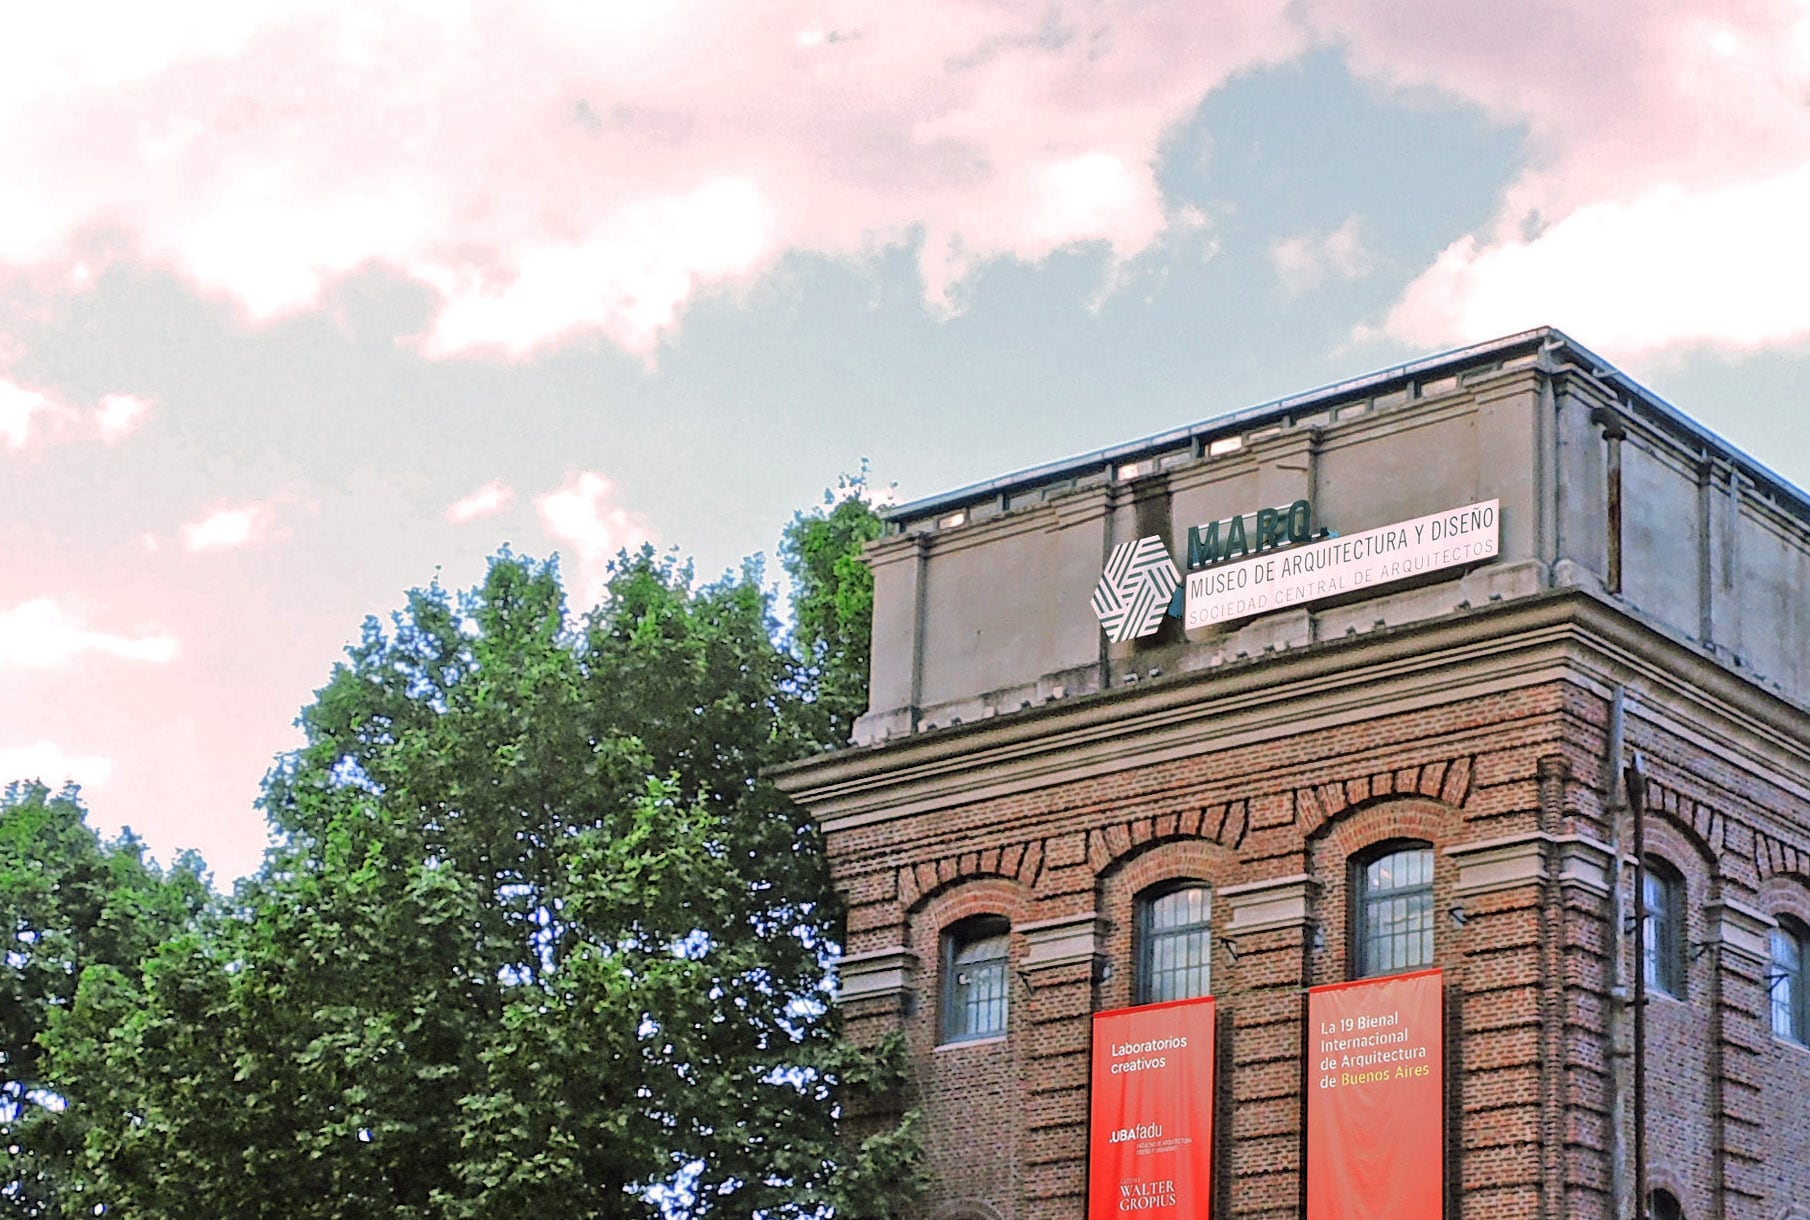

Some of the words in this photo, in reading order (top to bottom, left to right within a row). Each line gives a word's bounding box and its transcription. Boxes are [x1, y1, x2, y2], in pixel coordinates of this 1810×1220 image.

[1187, 500, 1328, 570] MARQ.
[1191, 567, 1248, 600] MUSEO
[1254, 560, 1276, 585] DE
[1281, 528, 1408, 579] ARQUITECTURA
[1415, 523, 1425, 545] Y
[1431, 507, 1494, 541] DISEÑO
[1189, 594, 1269, 626] SOCIEDAD
[1275, 577, 1346, 605] CENTRAL
[1354, 568, 1374, 585] DE
[1380, 539, 1493, 578] ARQUITECTOS
[1321, 1022, 1336, 1035] La
[1340, 1018, 1354, 1032] 19
[1357, 1011, 1399, 1030] Bienal
[1111, 1036, 1188, 1057] Laboratorios
[1321, 1027, 1409, 1053] Internacional
[1110, 1056, 1167, 1074] creativos
[1320, 1056, 1337, 1071] de
[1341, 1046, 1427, 1068] Arquitectura
[1320, 1074, 1337, 1089] de
[1341, 1070, 1390, 1086] Buenos
[1394, 1064, 1430, 1079] Aires
[1120, 1180, 1175, 1197] WALTER
[1119, 1193, 1177, 1212] GROPIUS
